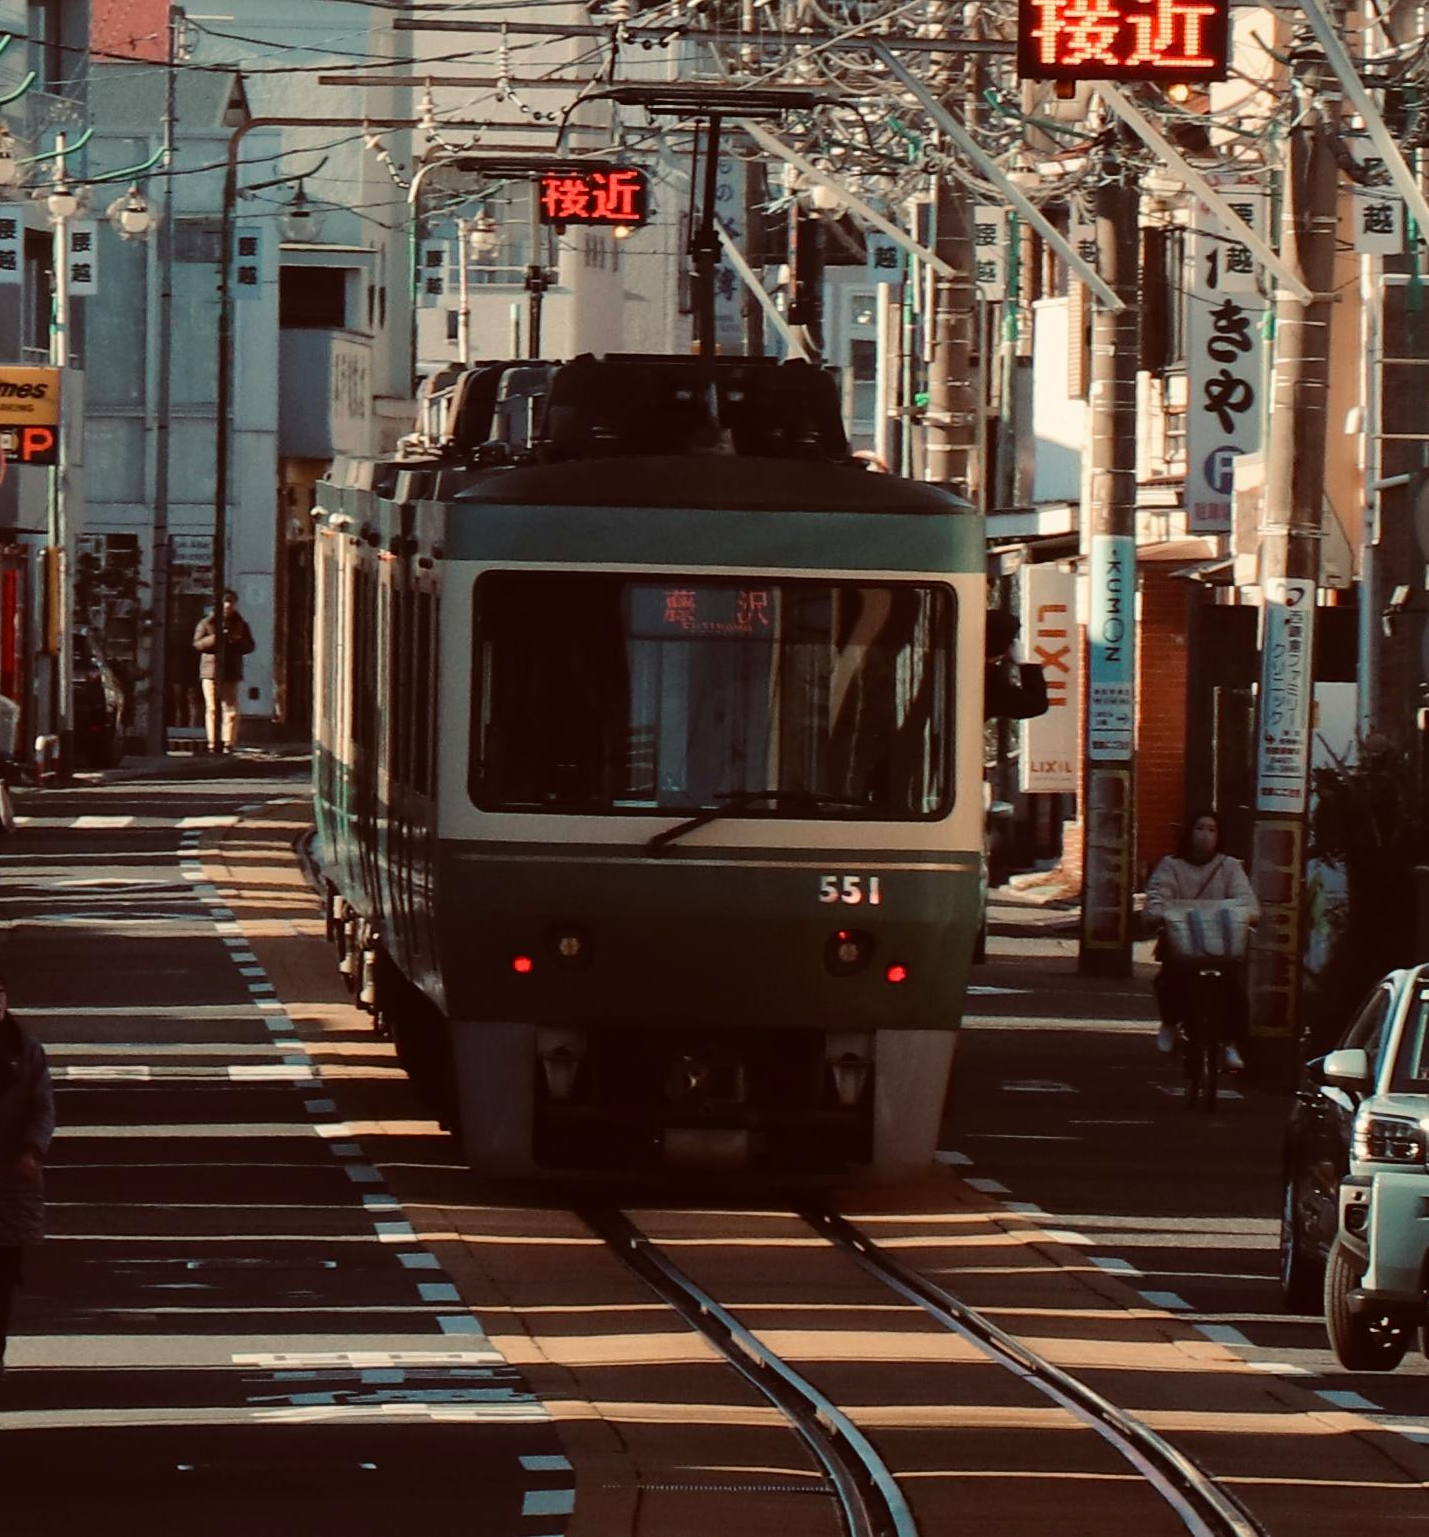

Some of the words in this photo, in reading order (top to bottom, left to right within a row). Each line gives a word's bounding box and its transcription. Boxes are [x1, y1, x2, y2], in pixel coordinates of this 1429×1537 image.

[541, 172, 641, 220] 接近
[23, 427, 54, 462] P
[1102, 561, 1124, 663] KUMON
[818, 875, 881, 906] 551
